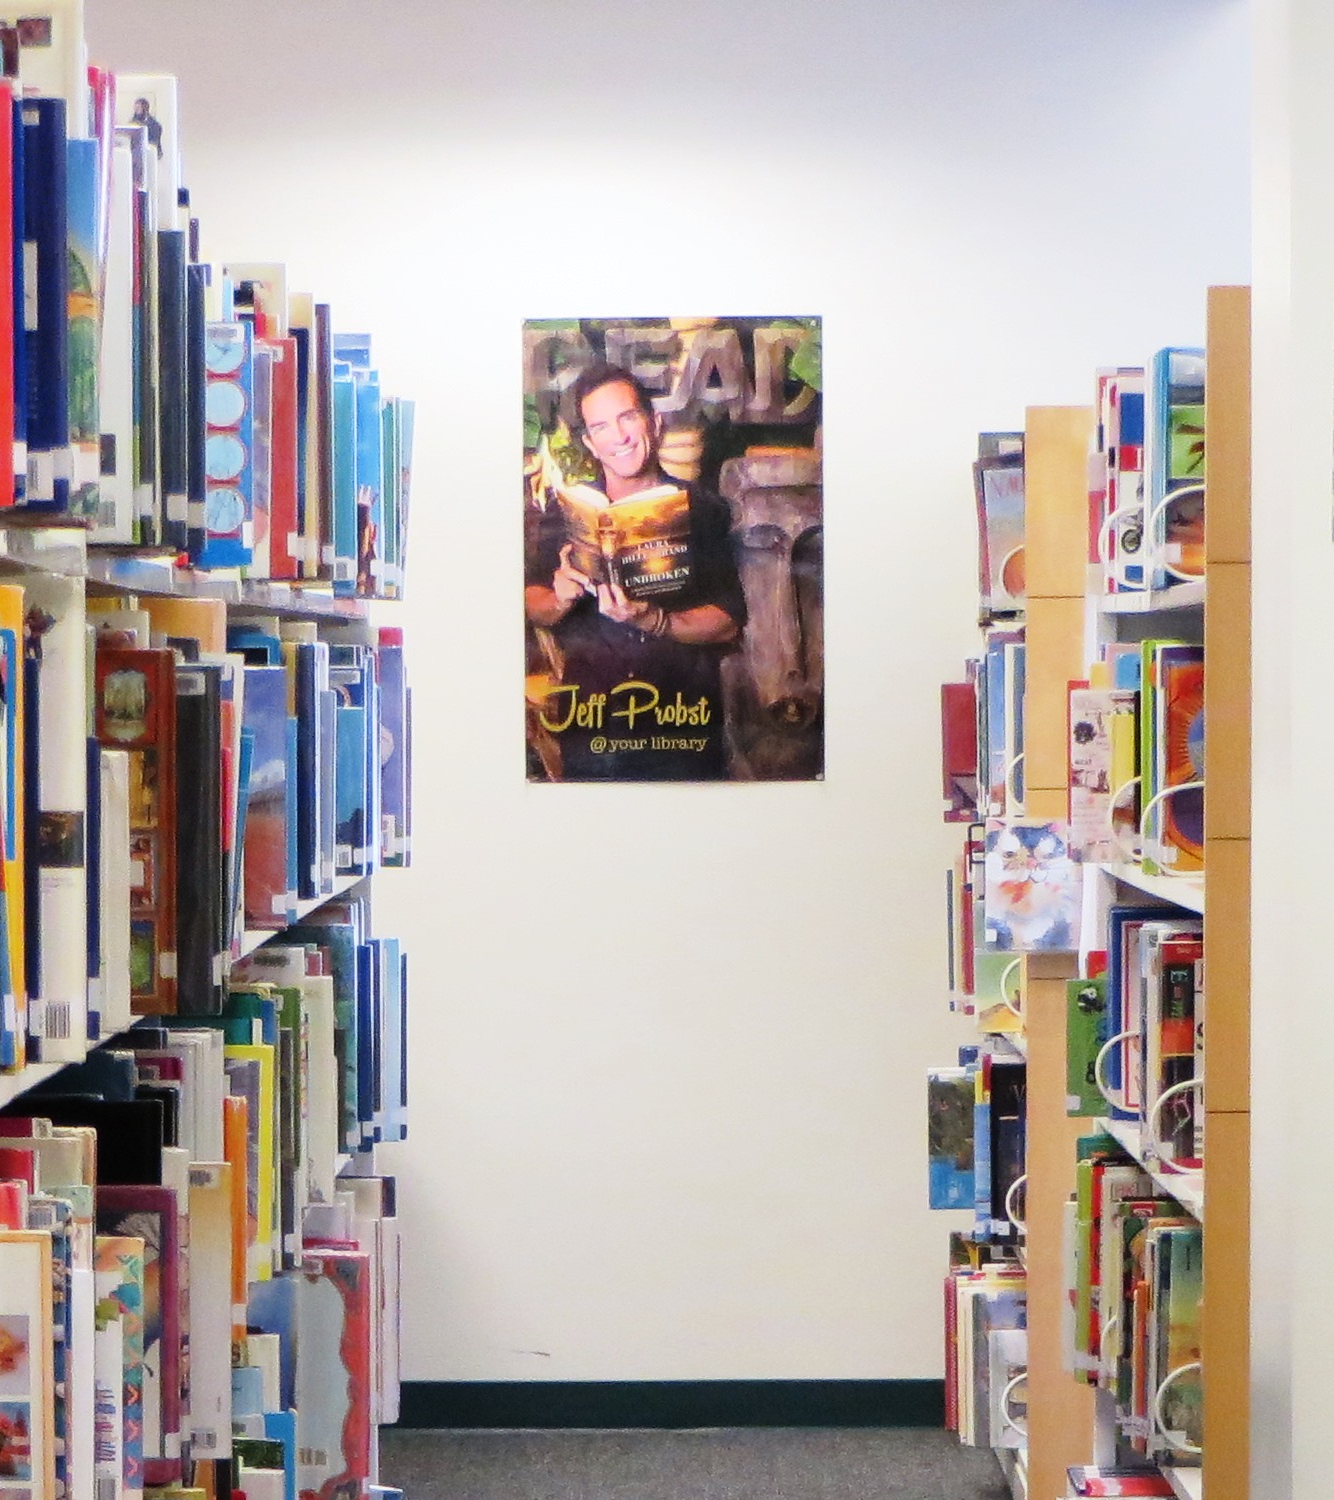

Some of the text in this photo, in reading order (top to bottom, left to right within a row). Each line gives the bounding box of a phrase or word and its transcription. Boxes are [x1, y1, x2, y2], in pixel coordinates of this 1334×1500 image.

[524, 328, 819, 425] READ
[637, 540, 670, 551] LAURA
[625, 567, 690, 588] UNBROKEN
[539, 681, 711, 732] Jeff Probst
[609, 739, 647, 752] your
[651, 737, 709, 752] library
